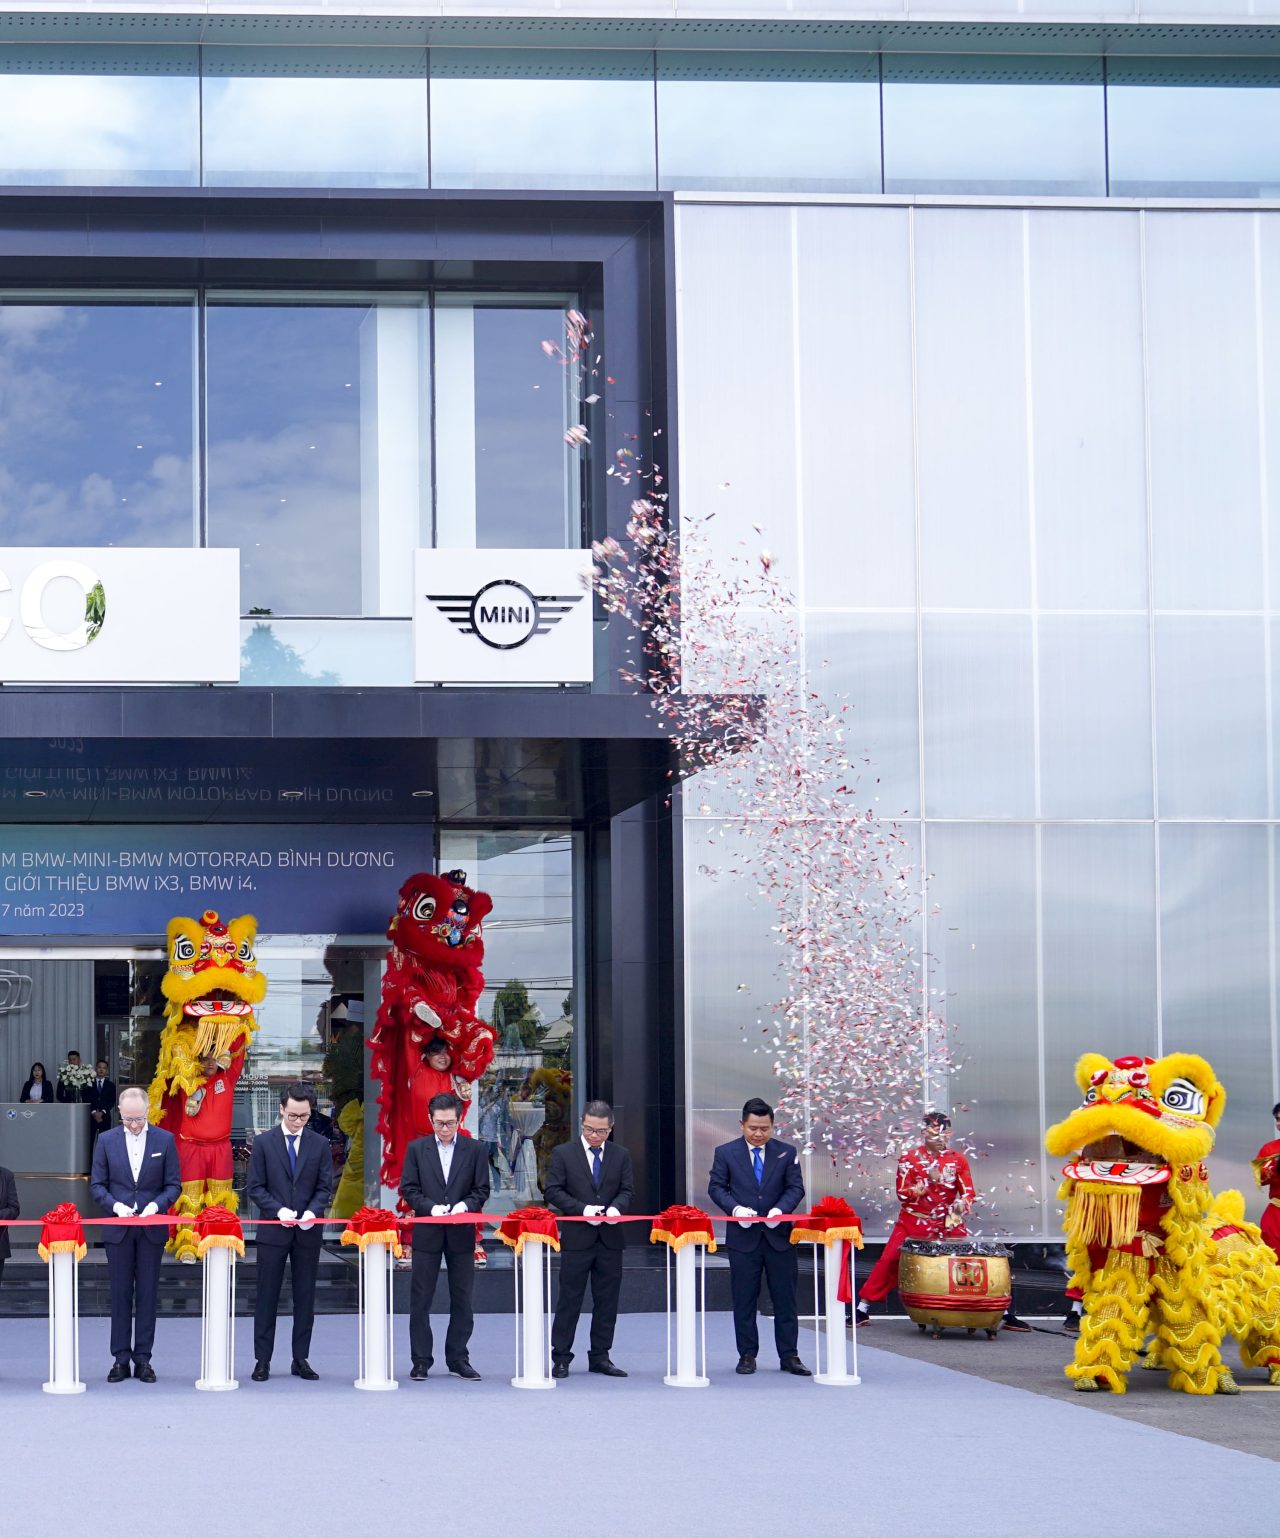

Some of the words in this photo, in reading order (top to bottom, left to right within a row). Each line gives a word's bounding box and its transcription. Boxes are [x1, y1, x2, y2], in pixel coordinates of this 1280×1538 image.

[480, 606, 530, 623] MINI
[22, 851, 163, 867] BMW-MINI-BMW
[169, 851, 272, 867] MOTORRAD
[278, 848, 321, 867] BÌNH
[327, 851, 395, 867] DƯƠNG
[4, 872, 41, 891] GIỚI
[45, 873, 100, 894] THIỆU
[106, 876, 150, 891] BMW
[154, 875, 184, 894] iX3,
[190, 875, 233, 890] BMW
[238, 875, 257, 890] i4.
[1, 904, 10, 917] 7
[14, 904, 45, 917] năm
[48, 904, 84, 917] 2023
